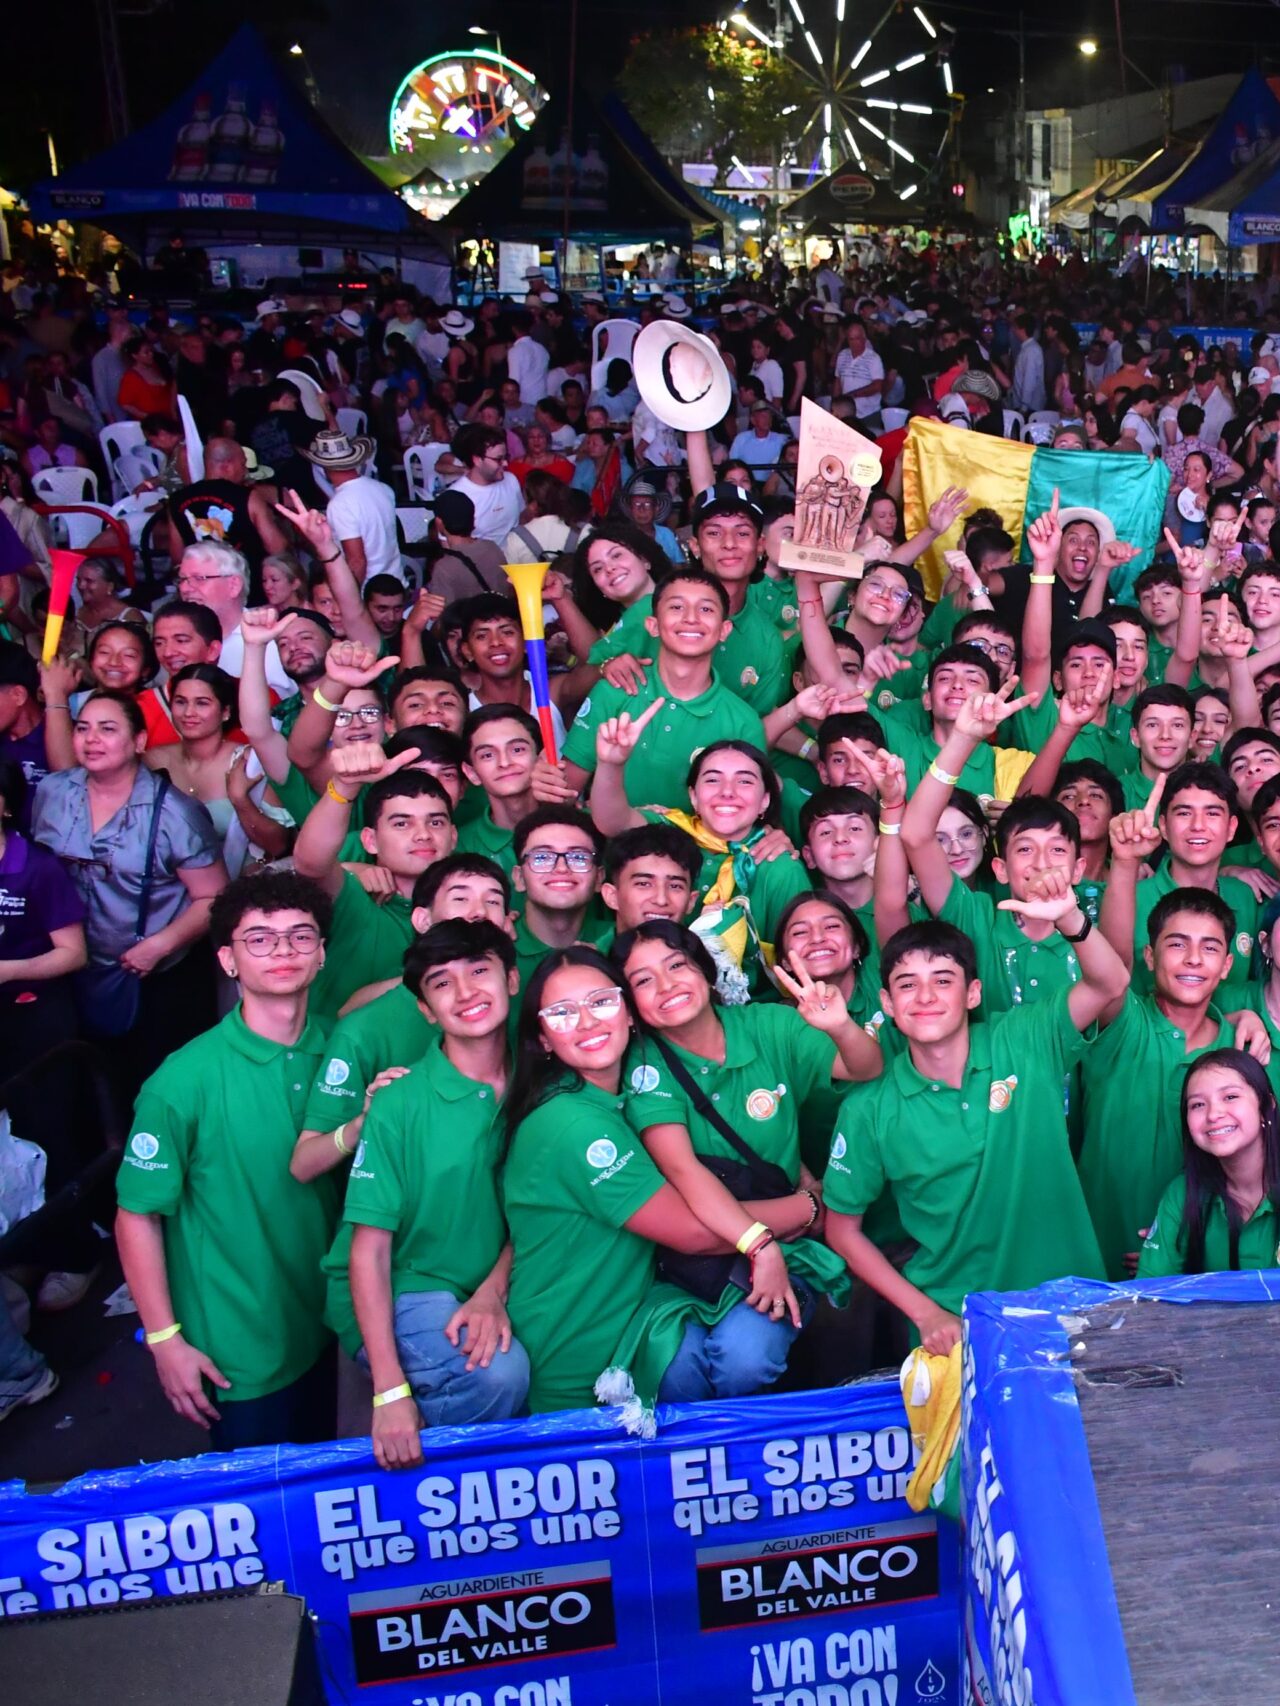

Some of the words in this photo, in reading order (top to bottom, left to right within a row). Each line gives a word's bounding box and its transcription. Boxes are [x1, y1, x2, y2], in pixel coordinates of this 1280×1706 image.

[314, 1484, 402, 1544] EL
[416, 1458, 618, 1529] SABOR
[670, 1445, 749, 1500] EL
[673, 1492, 759, 1537] que
[771, 1480, 855, 1518] nos
[37, 1502, 260, 1583] SABOR
[321, 1535, 416, 1581] que
[427, 1522, 520, 1560] nos
[530, 1509, 622, 1546] une
[761, 1527, 876, 1555] AGUARDIENTE
[52, 1573, 154, 1610] nos
[165, 1556, 265, 1596] une
[419, 1571, 545, 1603] AGUARDIENTE
[721, 1545, 918, 1602] BLANCO
[757, 1598, 800, 1617] DEL
[807, 1587, 876, 1609] VALLE
[376, 1591, 592, 1653] BLANCO
[418, 1648, 465, 1670] DEL
[471, 1635, 548, 1660] VALLE
[750, 1637, 816, 1693] ¡VA
[825, 1625, 898, 1679] CON
